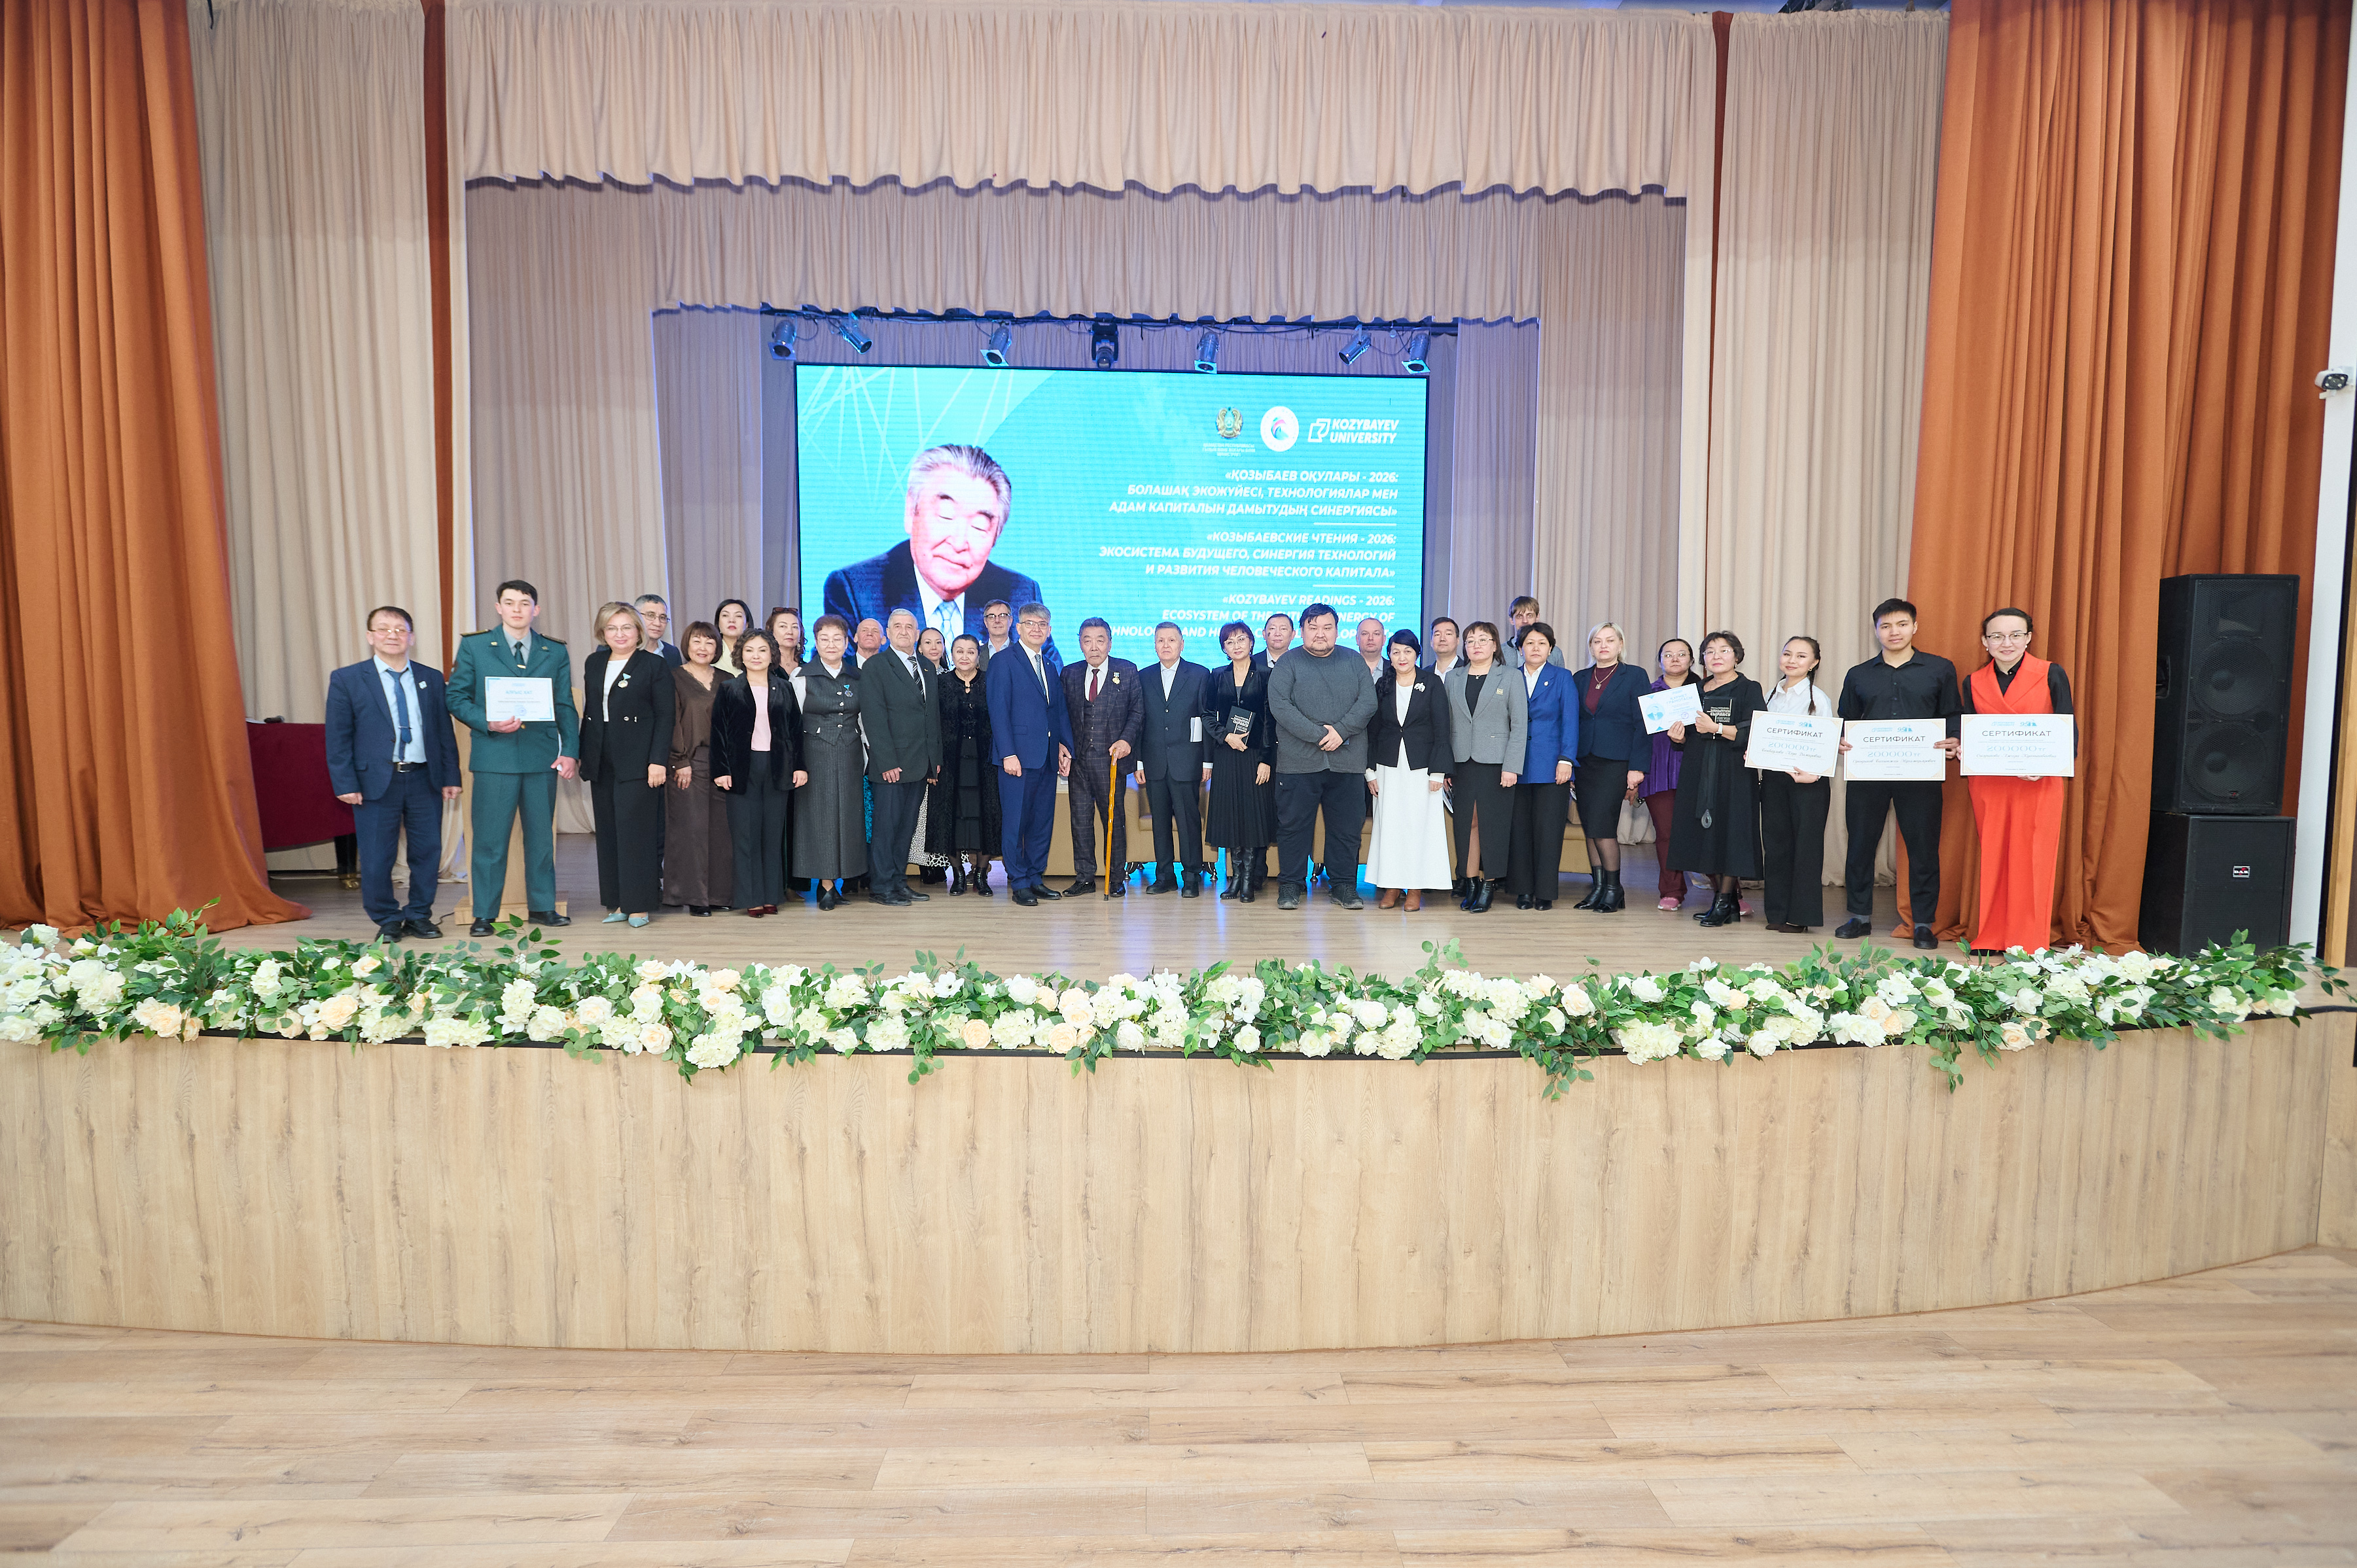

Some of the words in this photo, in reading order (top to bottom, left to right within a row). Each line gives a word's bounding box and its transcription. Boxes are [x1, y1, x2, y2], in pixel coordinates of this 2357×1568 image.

[1332, 419, 1399, 430] KOZYBAYEV
[1330, 432, 1396, 444] UNIVERSITY
[1226, 470, 1298, 481] «ҚОЗЫБАЕВ
[1300, 471, 1360, 483] ОҚУЛАРЫ
[1369, 472, 1398, 482] 2026:
[1128, 485, 1190, 497] БОЛАШАҚ
[1192, 485, 1264, 498] ЭКОЖҮЙЕСІ,
[1267, 487, 1370, 498] ТЕХНОЛОГИЯЛАР
[1372, 489, 1398, 498] МЕН
[1109, 502, 1146, 514] АДАМ
[1149, 502, 1225, 514] КАПИТАЛЫН
[1226, 504, 1307, 516] ДАМЫТУДЫҢ
[1311, 505, 1397, 516] СИНЕРГИЯСЫ»
[1207, 532, 1309, 542] «КОЗЫБАЕВСКИЕ
[1312, 533, 1358, 543] ЧТЕНИЯ
[1367, 534, 1396, 544] 2026:
[1099, 546, 1179, 557] ЭКОСИСТЕМА
[1183, 548, 1249, 560] БУДУЩЕГО,
[1253, 549, 1315, 559] СИНЕРГИЯ
[1318, 549, 1396, 561] ТЕХНОЛОГИЙ
[1146, 565, 1154, 574] И
[1157, 565, 1219, 575] РАЗВИТИЯ
[1222, 566, 1322, 577] ЧЕЛОВЕЧЕСКОГО
[1326, 567, 1395, 577] КАПИТАЛА»
[1223, 594, 1297, 604] «KOZYBAYEV
[1299, 595, 1356, 605] READINGS
[1366, 595, 1395, 606] 2026:
[1162, 610, 1230, 620] ECOSYSTEM
[1232, 611, 1248, 621] OF
[1379, 612, 1395, 622] OF
[1182, 627, 1206, 637] AND
[1767, 727, 1823, 738] СЕРТИФИКАТ
[1768, 742, 1809, 751] 200000
